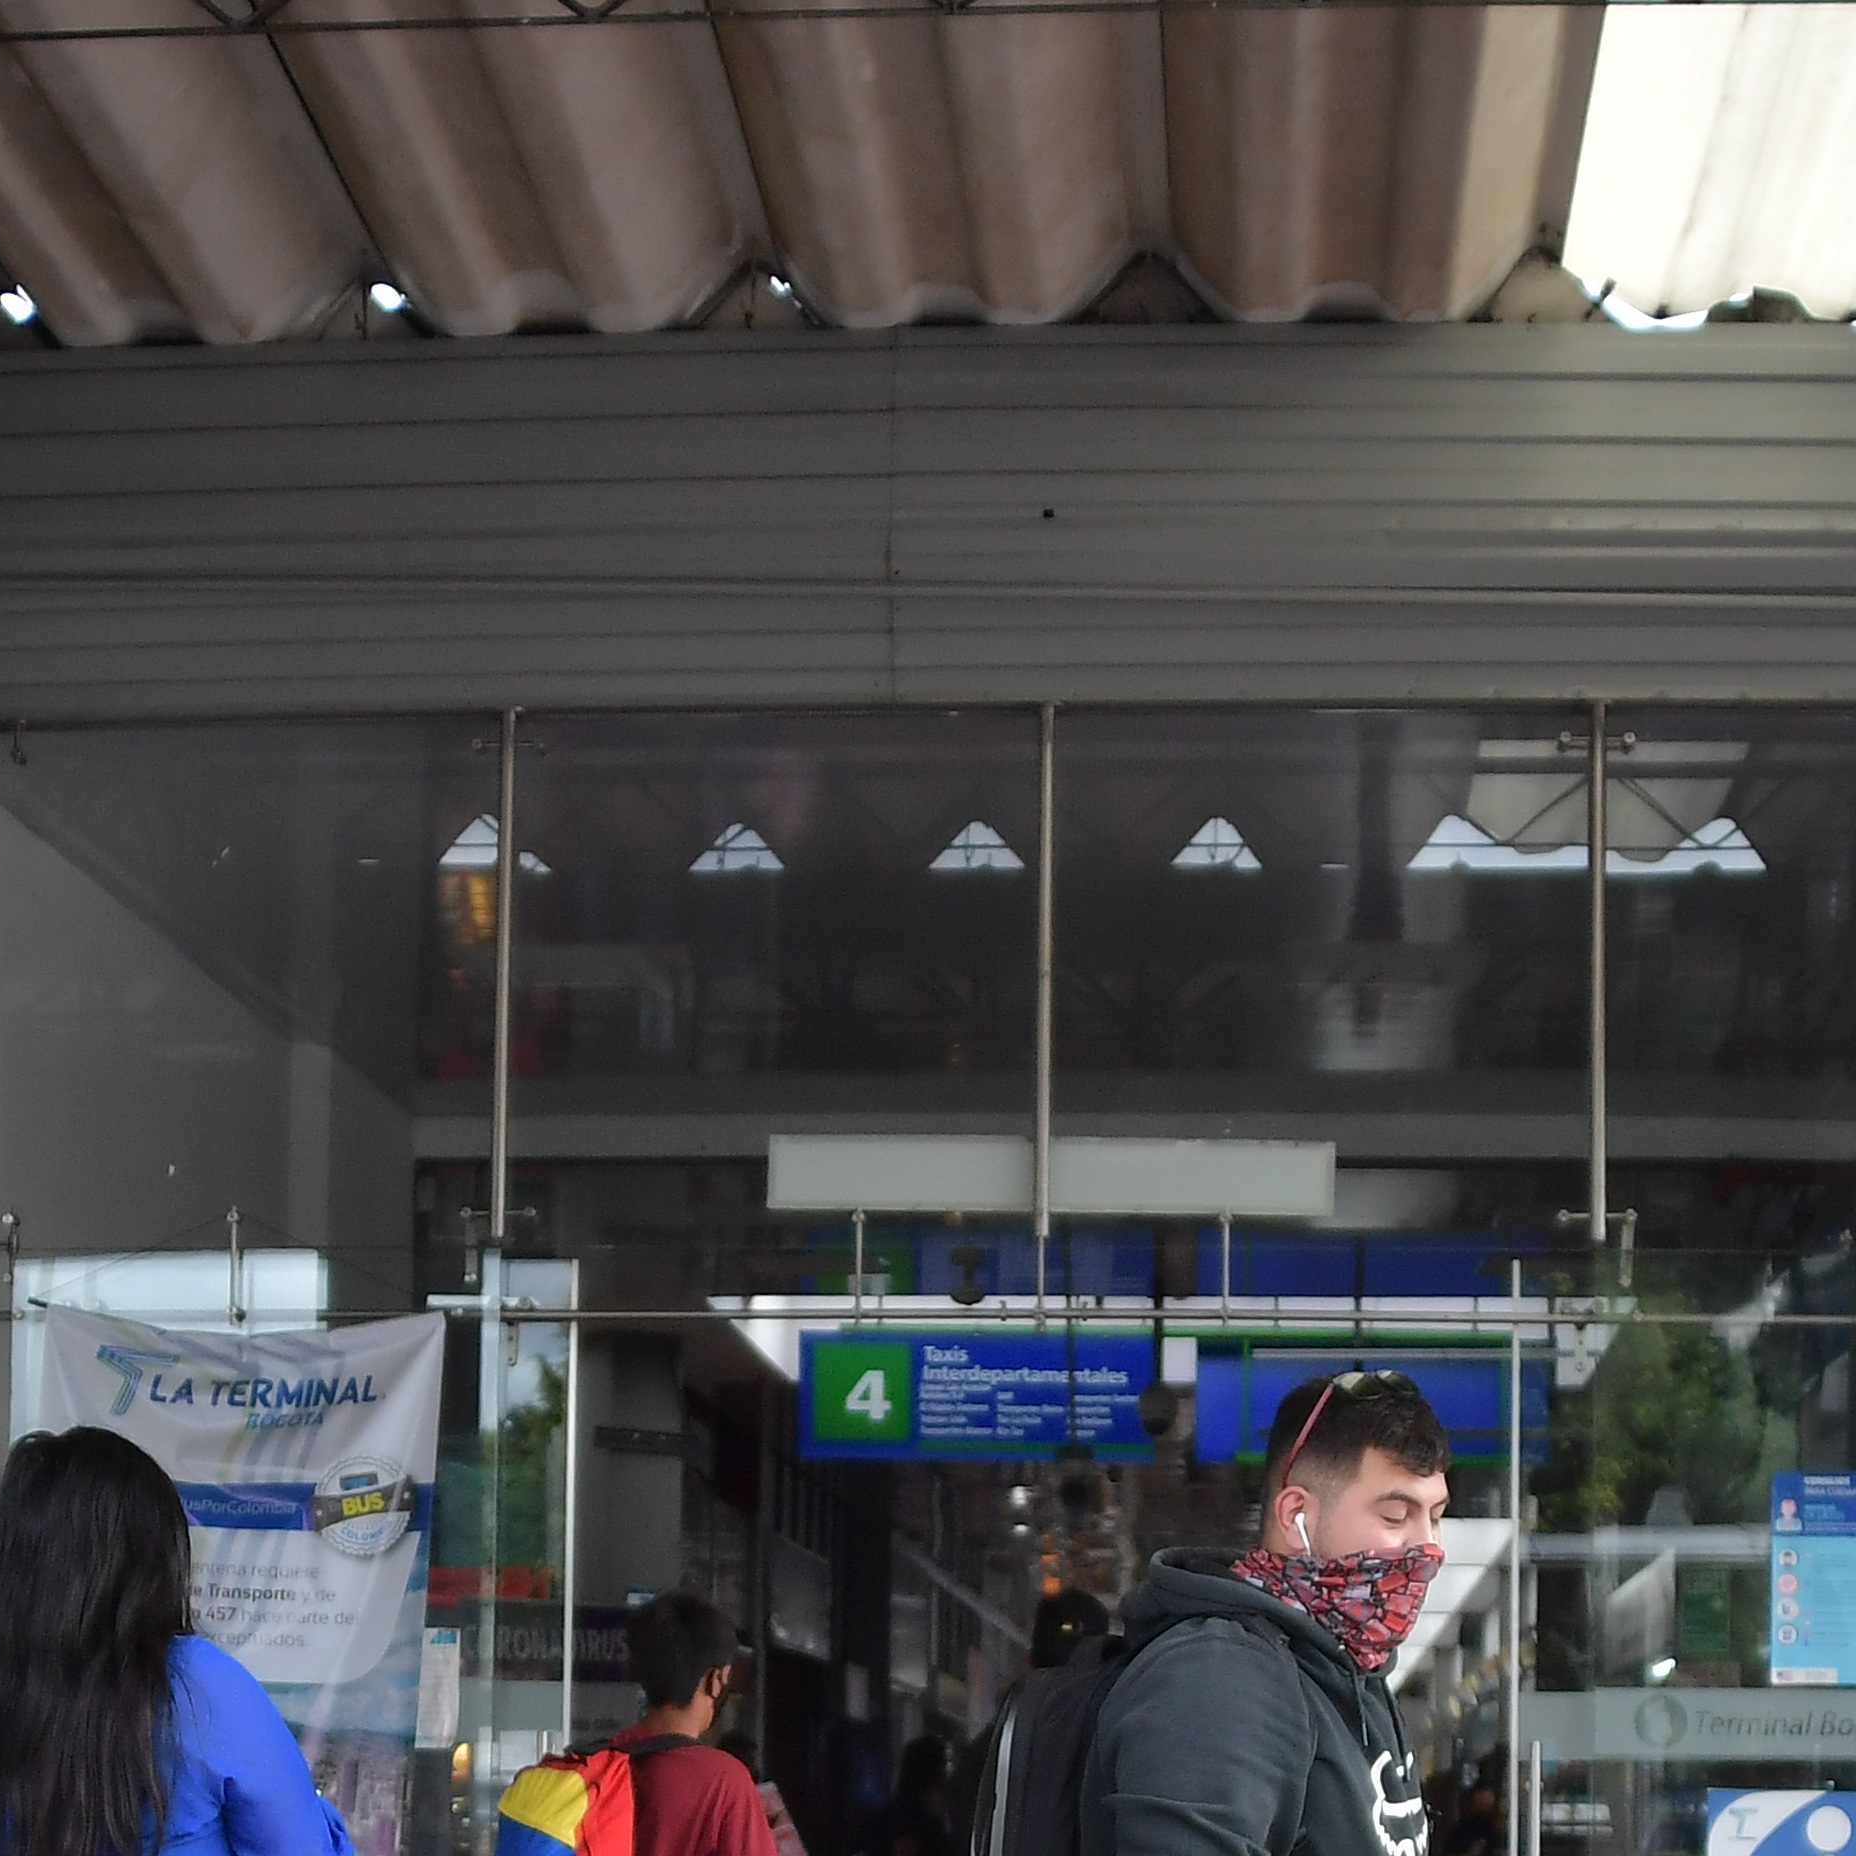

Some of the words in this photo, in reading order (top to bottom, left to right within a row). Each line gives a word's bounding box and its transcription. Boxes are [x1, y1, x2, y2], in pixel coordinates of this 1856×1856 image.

[923, 1345, 969, 1362] Taxis
[150, 1373, 194, 1404] LA
[208, 1374, 378, 1409] TERMINAL
[845, 1369, 893, 1422] 4
[181, 1499, 300, 1517] usPorColombia
[342, 1493, 385, 1518] BUS
[208, 1583, 296, 1602] Transporte
[206, 1606, 237, 1621] 457
[334, 1611, 355, 1625] de
[1693, 1709, 1814, 1737] Terminal
